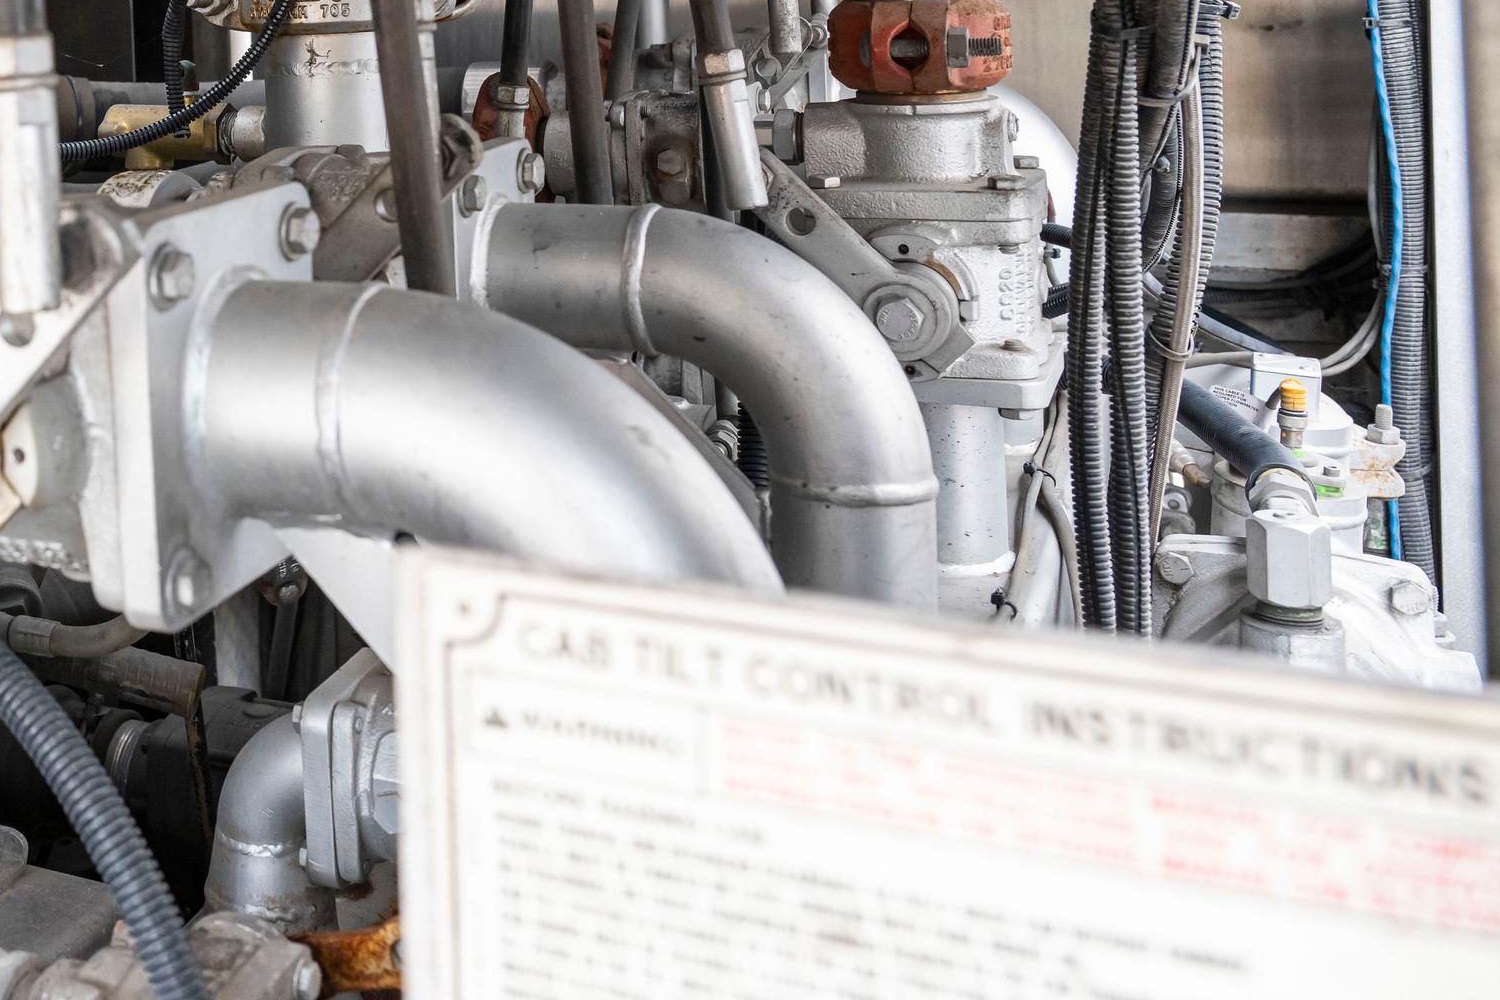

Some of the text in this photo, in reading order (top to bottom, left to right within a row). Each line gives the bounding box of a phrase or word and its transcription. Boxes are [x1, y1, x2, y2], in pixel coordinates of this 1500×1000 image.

[320, 3, 351, 18] 705
[518, 618, 1490, 804] CAB TILT CONTROL INSTRUCTIONS
